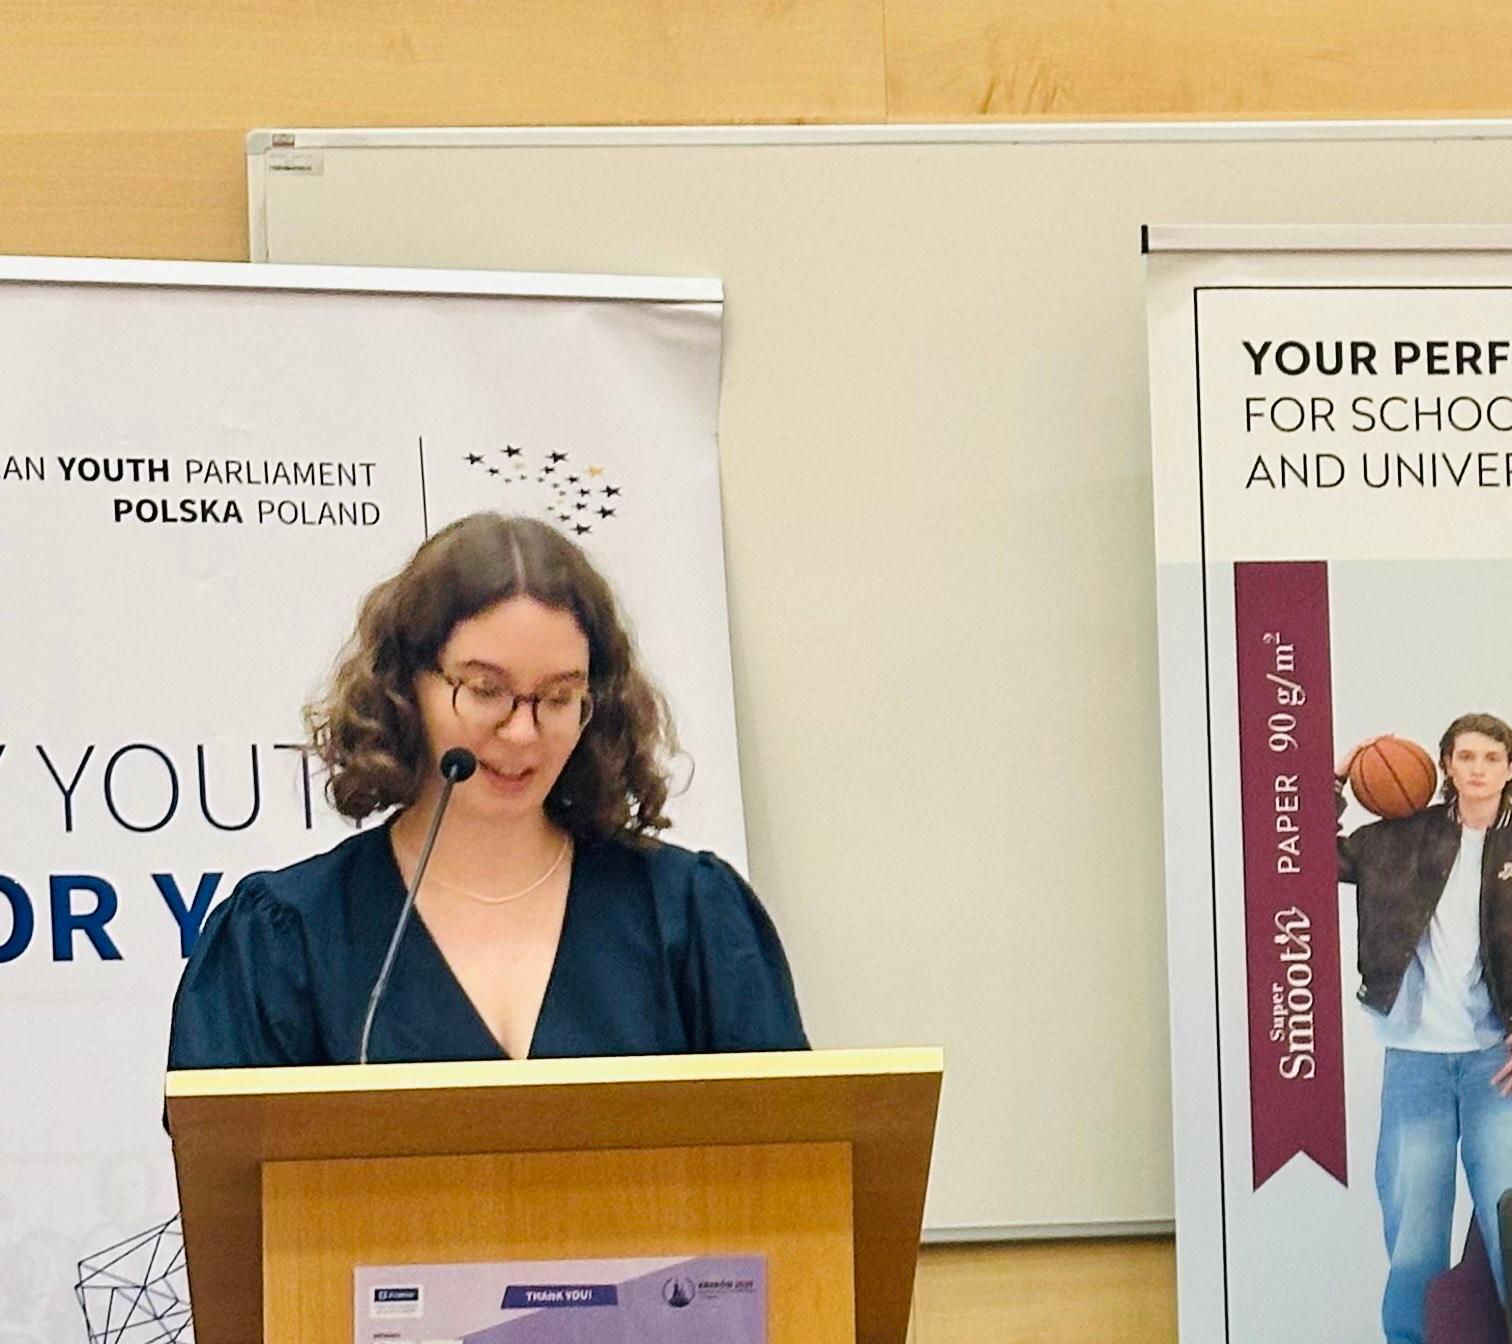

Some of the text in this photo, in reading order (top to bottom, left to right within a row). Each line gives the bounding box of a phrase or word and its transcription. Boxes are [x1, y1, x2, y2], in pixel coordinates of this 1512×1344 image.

[1243, 341, 1377, 376] YOUR
[1246, 397, 1335, 432] FOR
[58, 457, 169, 482] YOUTH
[186, 460, 376, 486] PARLIAMENT
[1246, 453, 1345, 488] AND
[113, 499, 380, 526] POLSKA POLAND
[1268, 712, 1298, 752] 90
[36, 743, 362, 833] YOUT
[1275, 774, 1301, 874] PAPER
[1274, 906, 1316, 1079] Smooth
[1270, 982, 1288, 1041] Super
